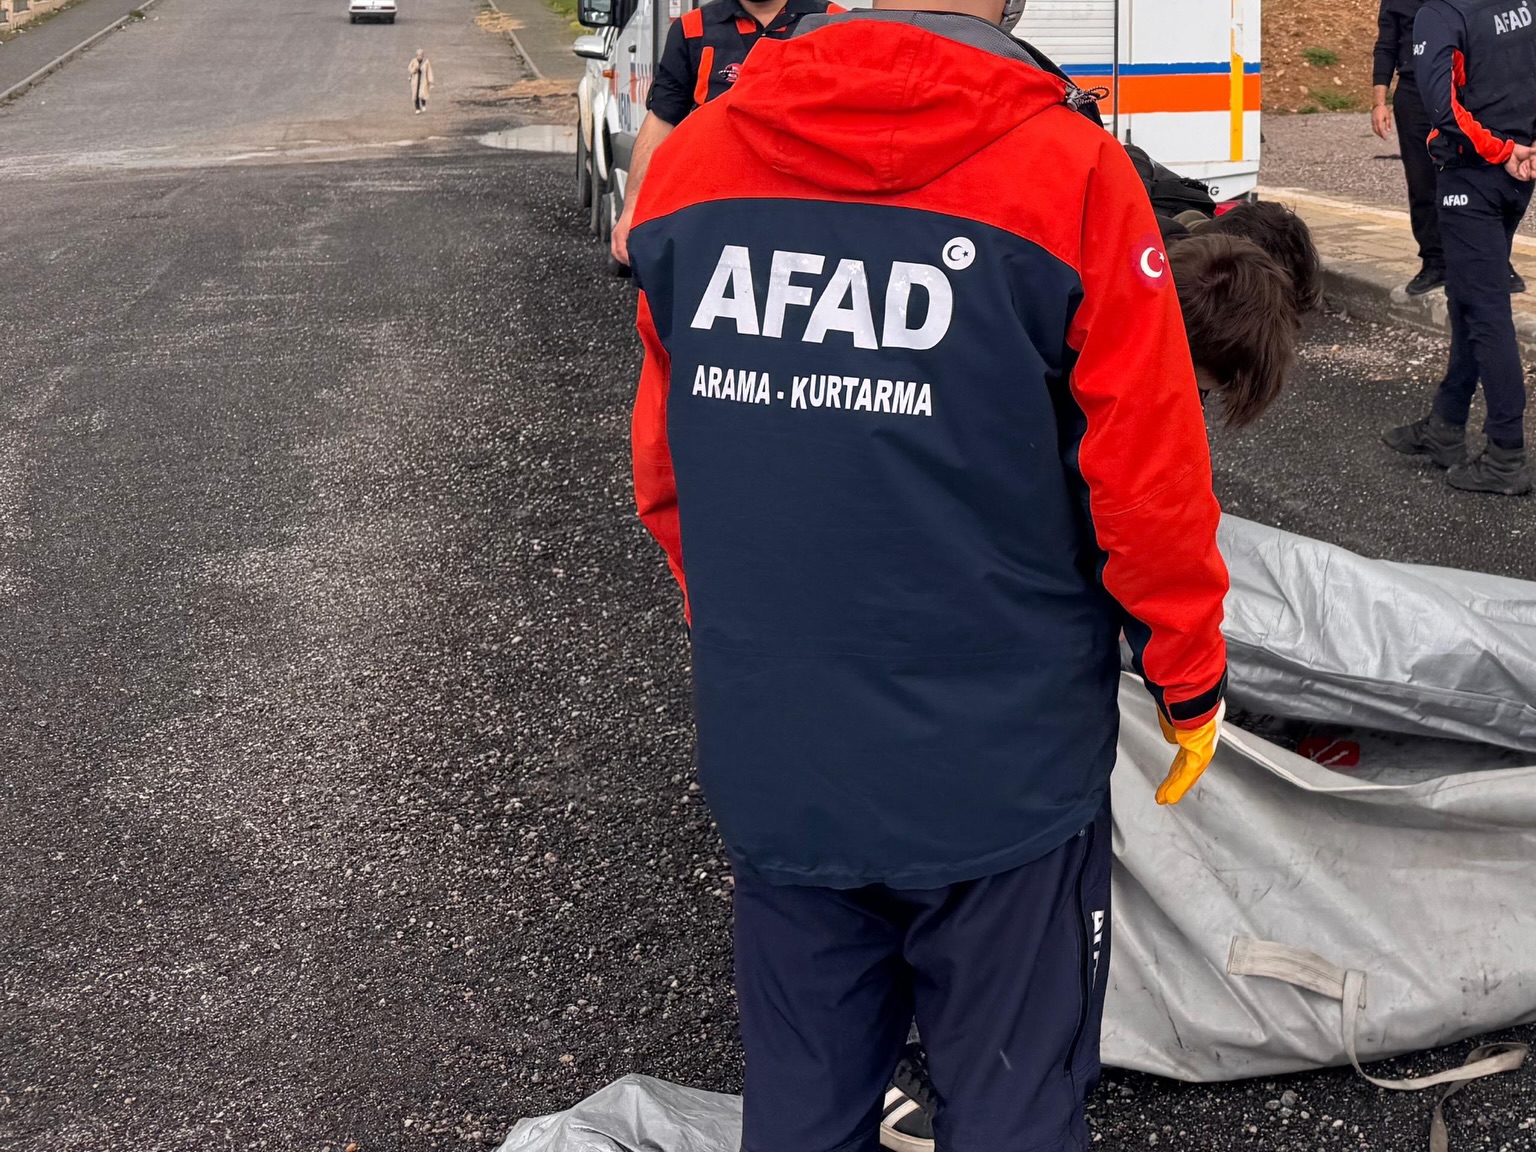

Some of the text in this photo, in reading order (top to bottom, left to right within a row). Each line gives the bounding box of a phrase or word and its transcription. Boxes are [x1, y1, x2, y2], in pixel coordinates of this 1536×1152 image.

[1494, 6, 1533, 35] AFAD
[1443, 194, 1469, 206] AFAD
[690, 244, 954, 351] AFAD
[692, 364, 771, 405] ARAMA
[790, 373, 933, 417] KURTARMA
